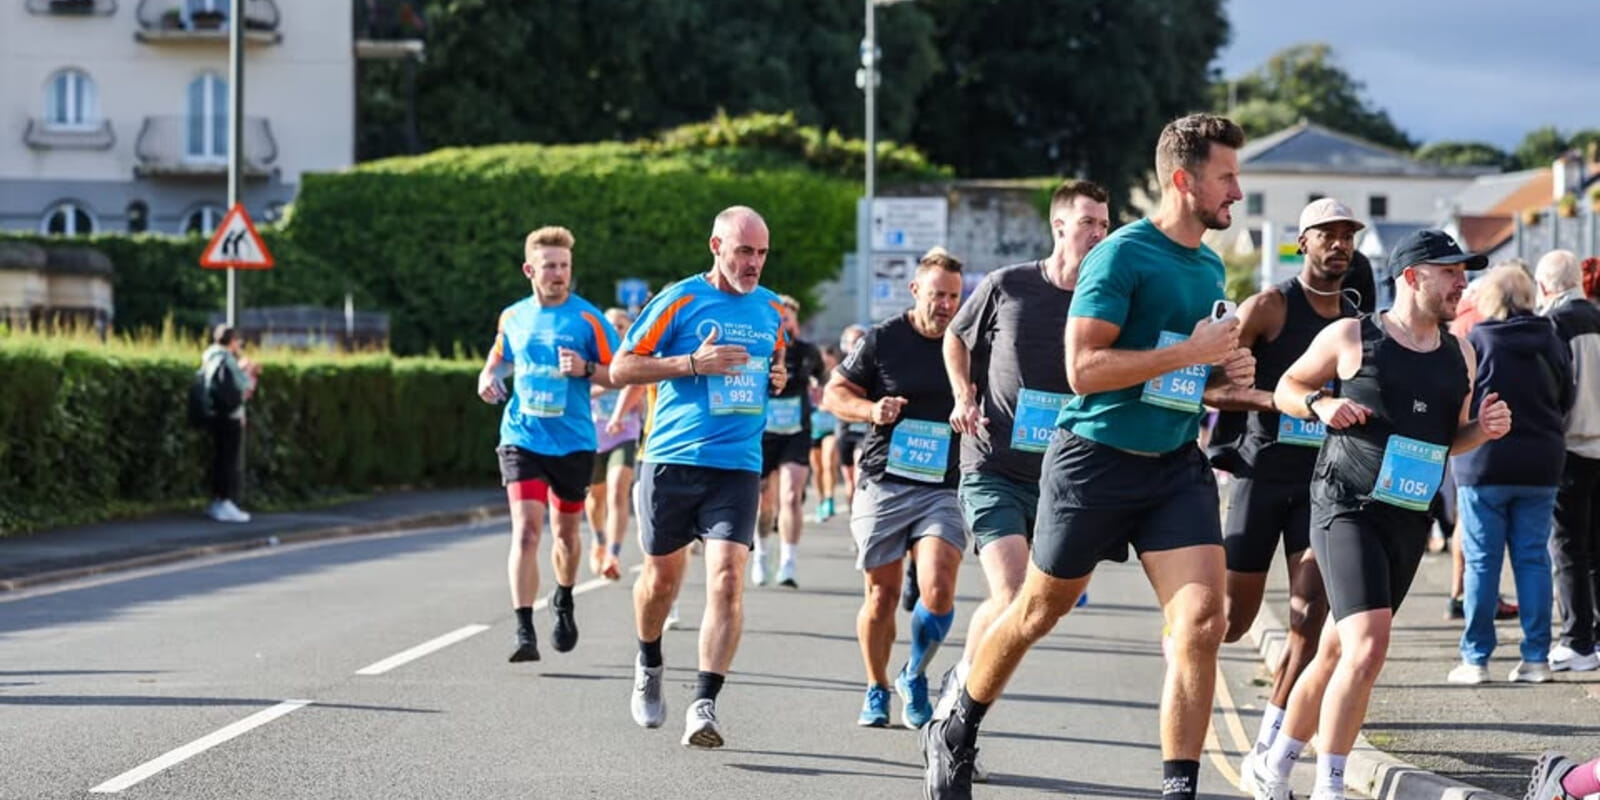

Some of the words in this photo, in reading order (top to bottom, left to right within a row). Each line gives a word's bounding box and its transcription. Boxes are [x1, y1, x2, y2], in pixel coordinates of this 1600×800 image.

[724, 327, 745, 337] LUNG
[1176, 364, 1206, 378] LES
[724, 375, 757, 387] PAUL
[1171, 377, 1196, 396] 548
[730, 390, 754, 403] 992
[907, 436, 939, 451] MIKE
[909, 450, 933, 464] 747
